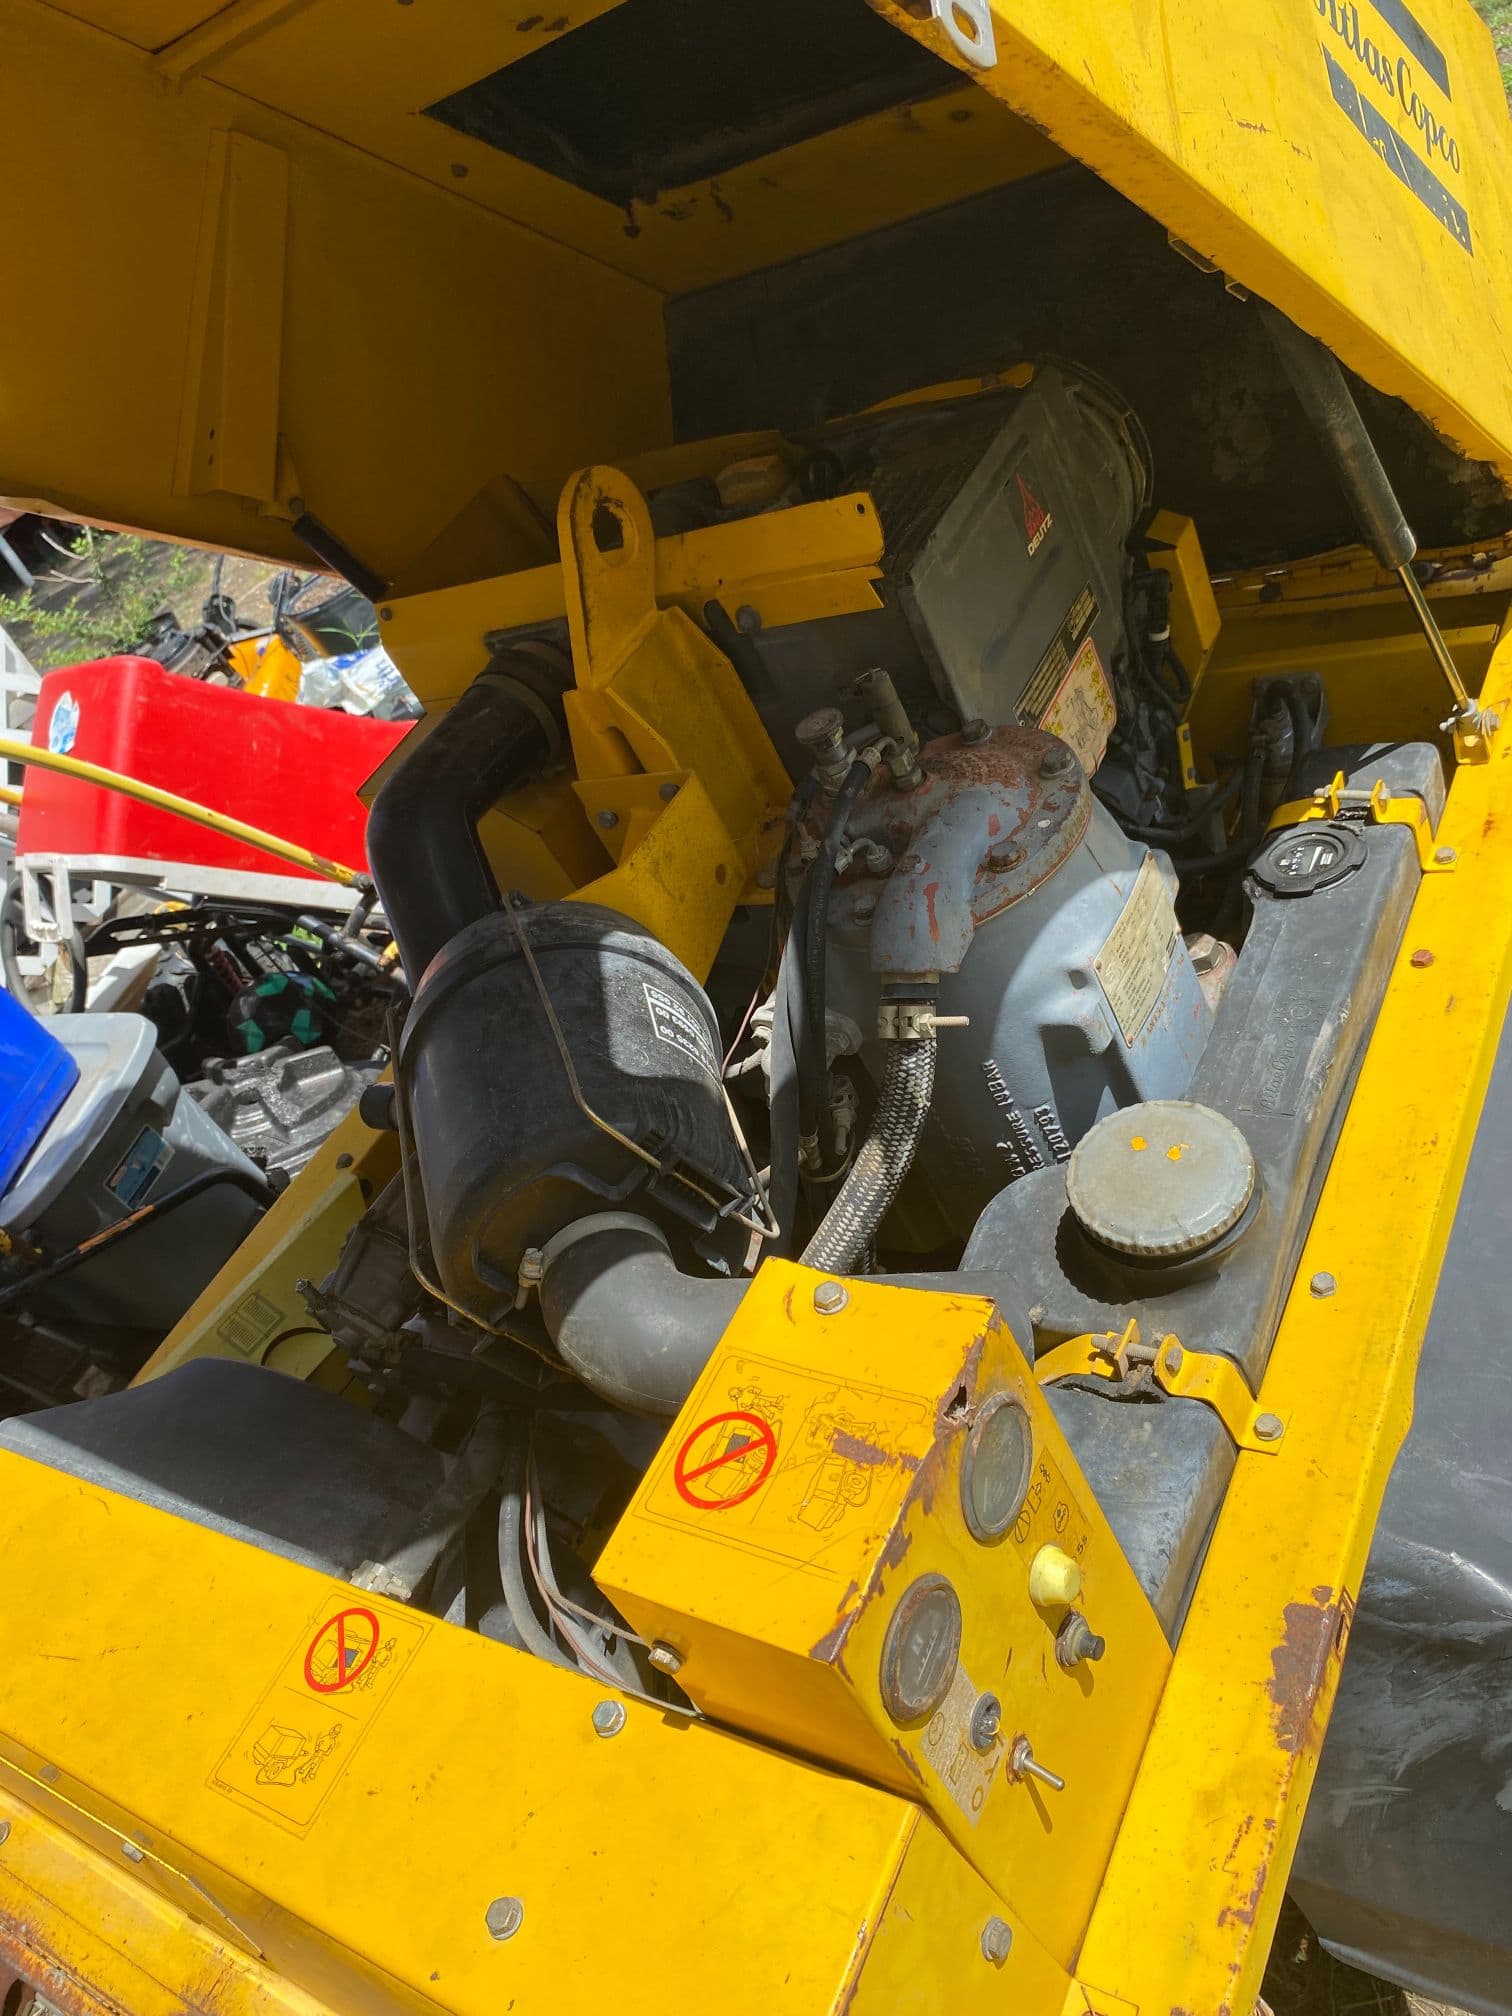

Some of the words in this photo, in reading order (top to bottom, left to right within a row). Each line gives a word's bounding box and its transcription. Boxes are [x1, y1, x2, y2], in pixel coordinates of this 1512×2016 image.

[1397, 57, 1460, 173] Copco
[1028, 513, 1053, 557] DEUTZ
[1006, 1110, 1045, 1169] RESSURE
